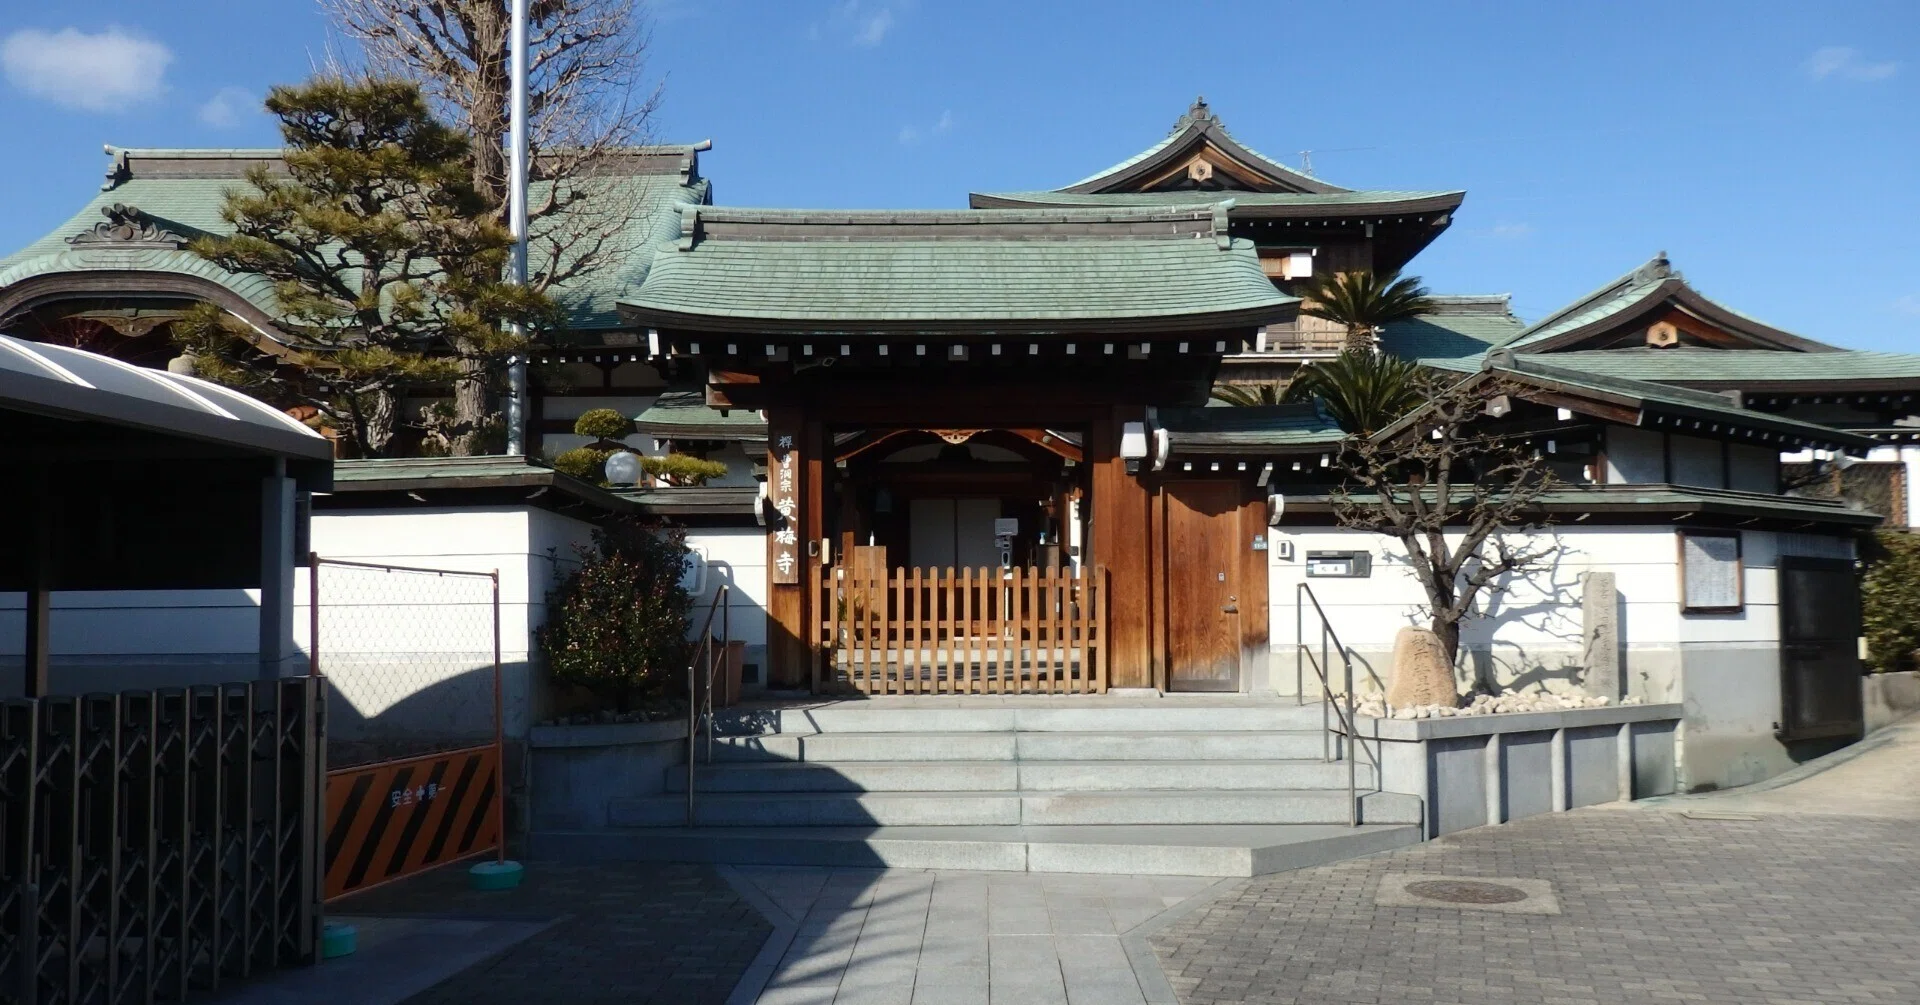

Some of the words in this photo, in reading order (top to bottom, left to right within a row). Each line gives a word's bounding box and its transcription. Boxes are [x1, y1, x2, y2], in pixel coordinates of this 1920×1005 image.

[775, 497, 797, 575] 黄梅寺
[391, 788, 412, 808] 安全
